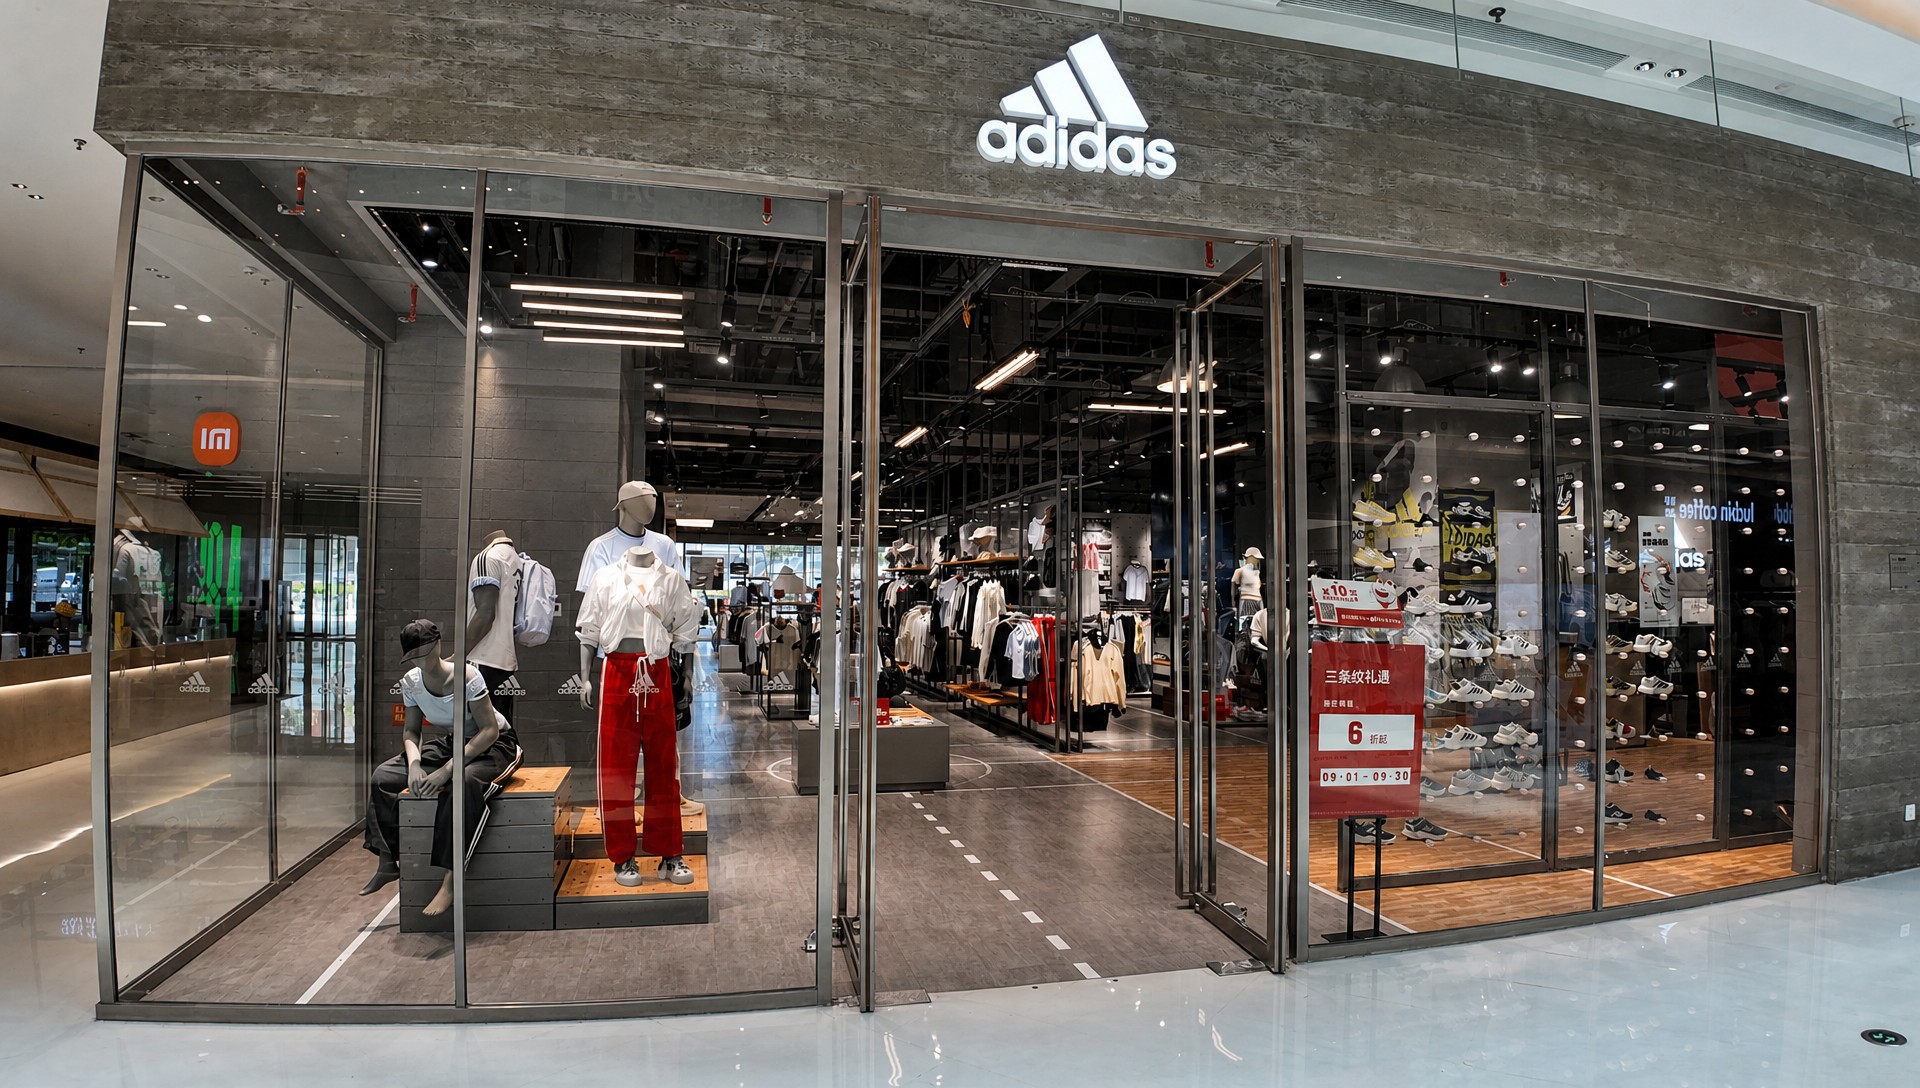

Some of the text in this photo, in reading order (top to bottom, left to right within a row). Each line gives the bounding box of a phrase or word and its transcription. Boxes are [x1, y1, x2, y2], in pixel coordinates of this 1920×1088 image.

[976, 114, 1177, 180] adidas
[1324, 669, 1391, 685] 三条纹礼遇
[179, 684, 211, 694] adidas
[494, 686, 526, 696] adidas
[1347, 720, 1364, 745] 6
